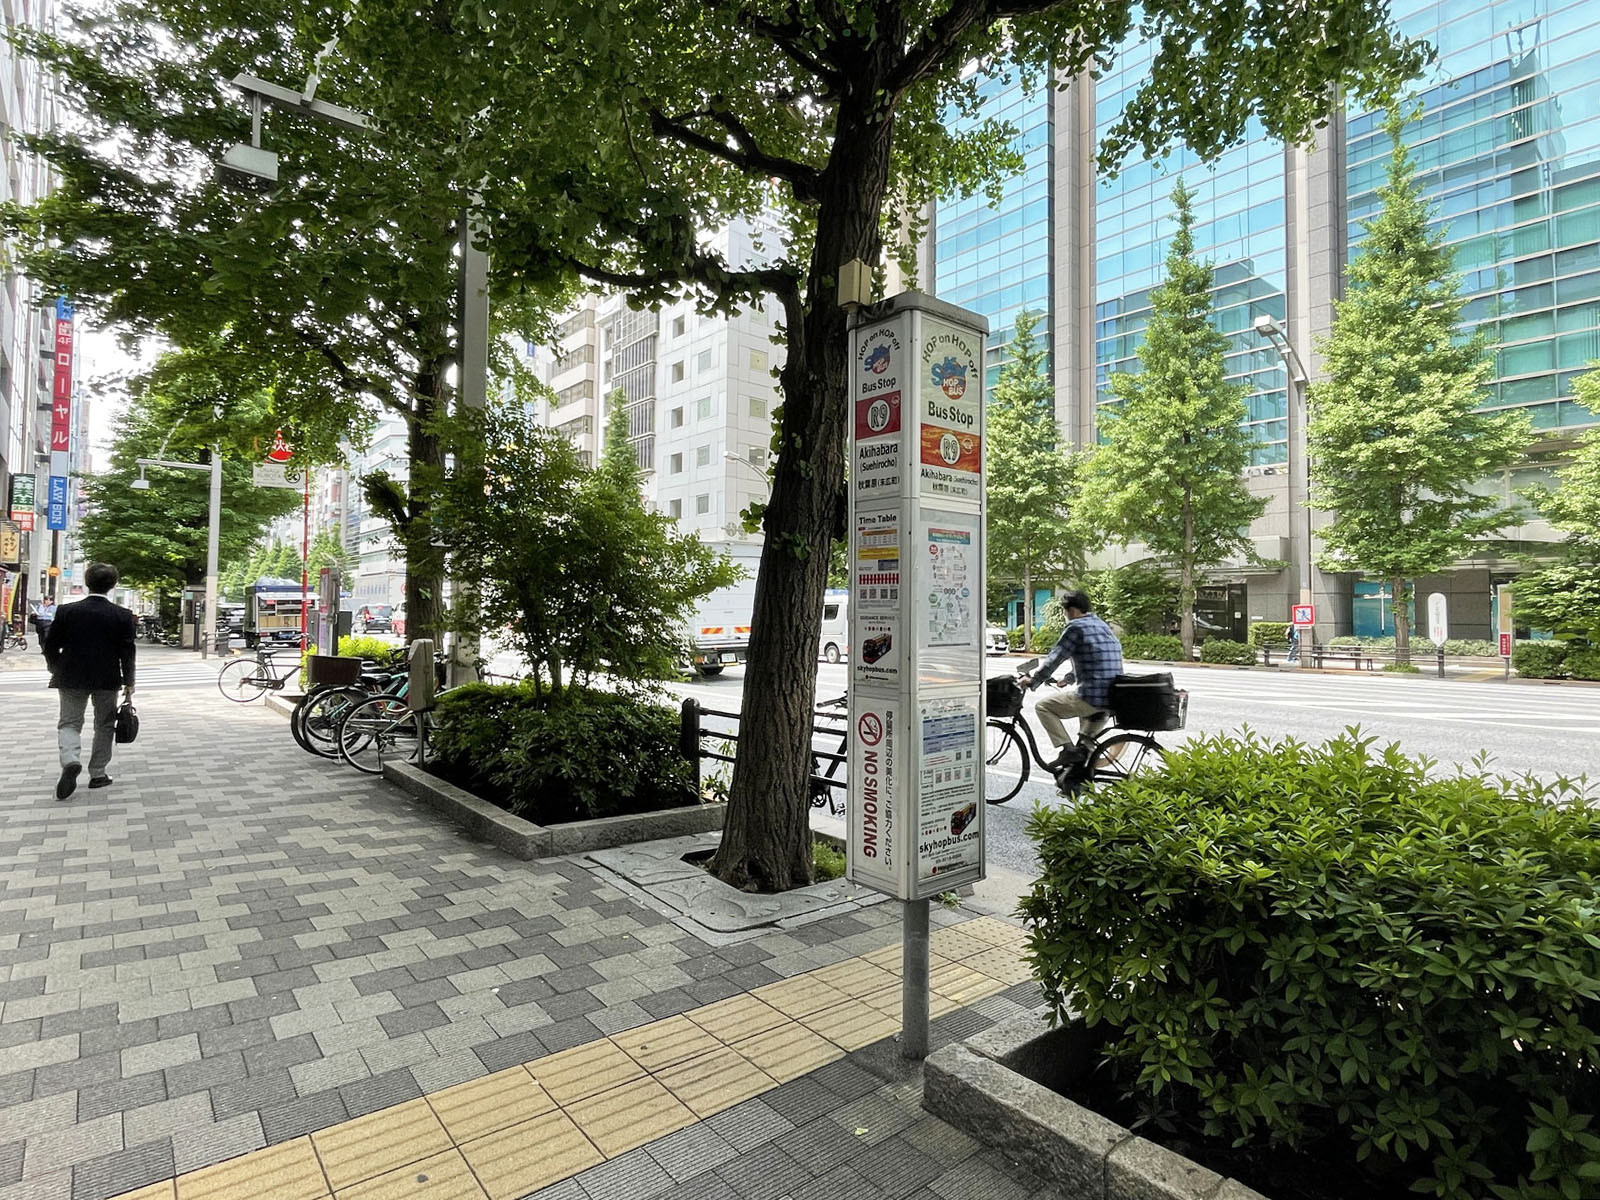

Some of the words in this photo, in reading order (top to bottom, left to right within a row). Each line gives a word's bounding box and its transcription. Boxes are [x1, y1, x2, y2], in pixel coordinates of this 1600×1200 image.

[57, 336, 73, 345] 4F
[857, 339, 870, 361] HOP
[869, 332, 879, 342] on
[878, 328, 895, 339] HOP
[892, 338, 901, 351] off
[922, 335, 938, 363] HOP
[938, 334, 951, 344] on
[951, 333, 972, 358] HOP
[968, 359, 979, 380] off
[931, 356, 968, 387] SKY
[943, 378, 959, 388] HOP
[862, 382, 877, 394] Bus
[877, 376, 897, 390] Stop
[948, 386, 964, 396] BUS
[52, 353, 71, 445] ローヤル
[870, 404, 888, 428] R9
[928, 400, 949, 421] Bus
[949, 406, 974, 429] Stop
[859, 443, 898, 460] Akihabara
[943, 437, 959, 461] R9
[920, 468, 953, 483] Akihabara
[51, 478, 64, 524] LAWSON
[858, 516, 877, 525] Time
[877, 513, 897, 523] Table
[856, 664, 898, 675] skyhopbus.com
[864, 750, 878, 775] NO
[863, 776, 878, 859] SMOKING
[919, 831, 980, 853] skyhopbus.com
